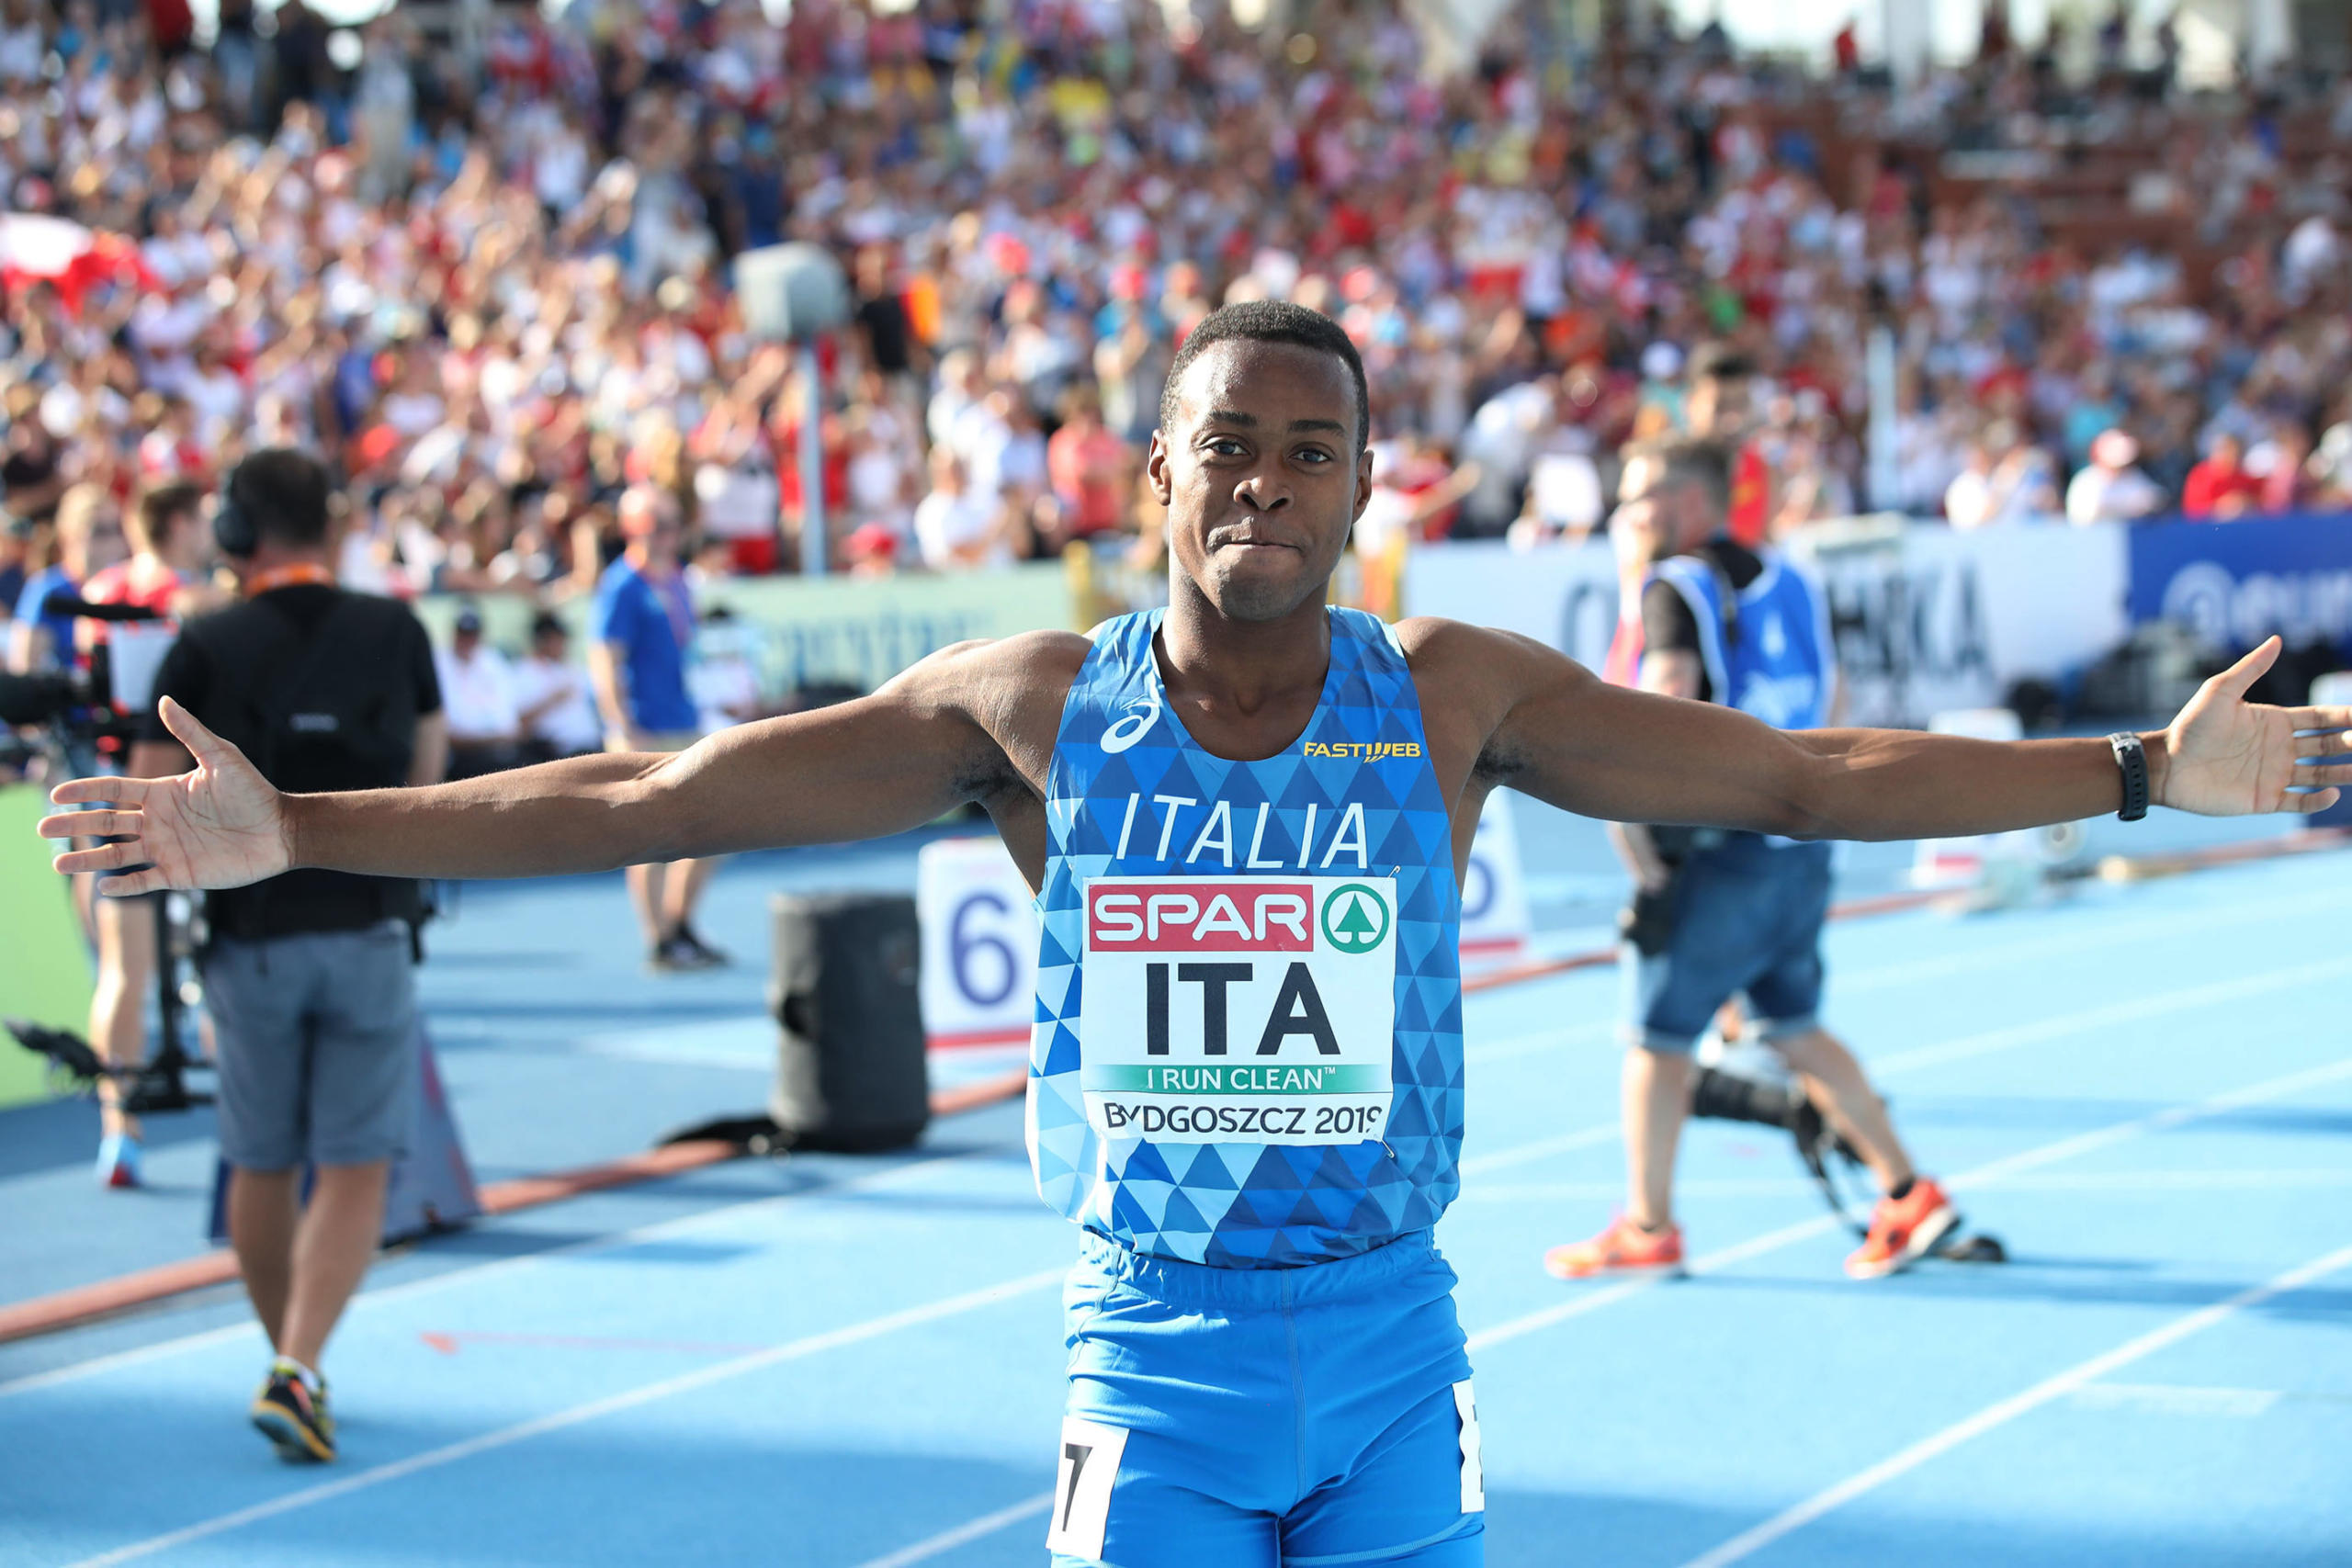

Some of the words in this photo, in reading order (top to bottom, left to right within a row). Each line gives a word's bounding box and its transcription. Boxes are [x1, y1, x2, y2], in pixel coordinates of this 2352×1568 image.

[1303, 741, 1422, 764] FASTWEB
[1114, 792, 1368, 870] ITALIA
[950, 890, 1016, 1008] 6
[1094, 892, 1308, 942] SPAR
[1145, 961, 1341, 1056] ITA
[1147, 1068, 1154, 1089] I
[1162, 1067, 1222, 1090] RUN
[1103, 1101, 1307, 1135] BYDGOSZCZ
[1061, 1441, 1094, 1533] 7
